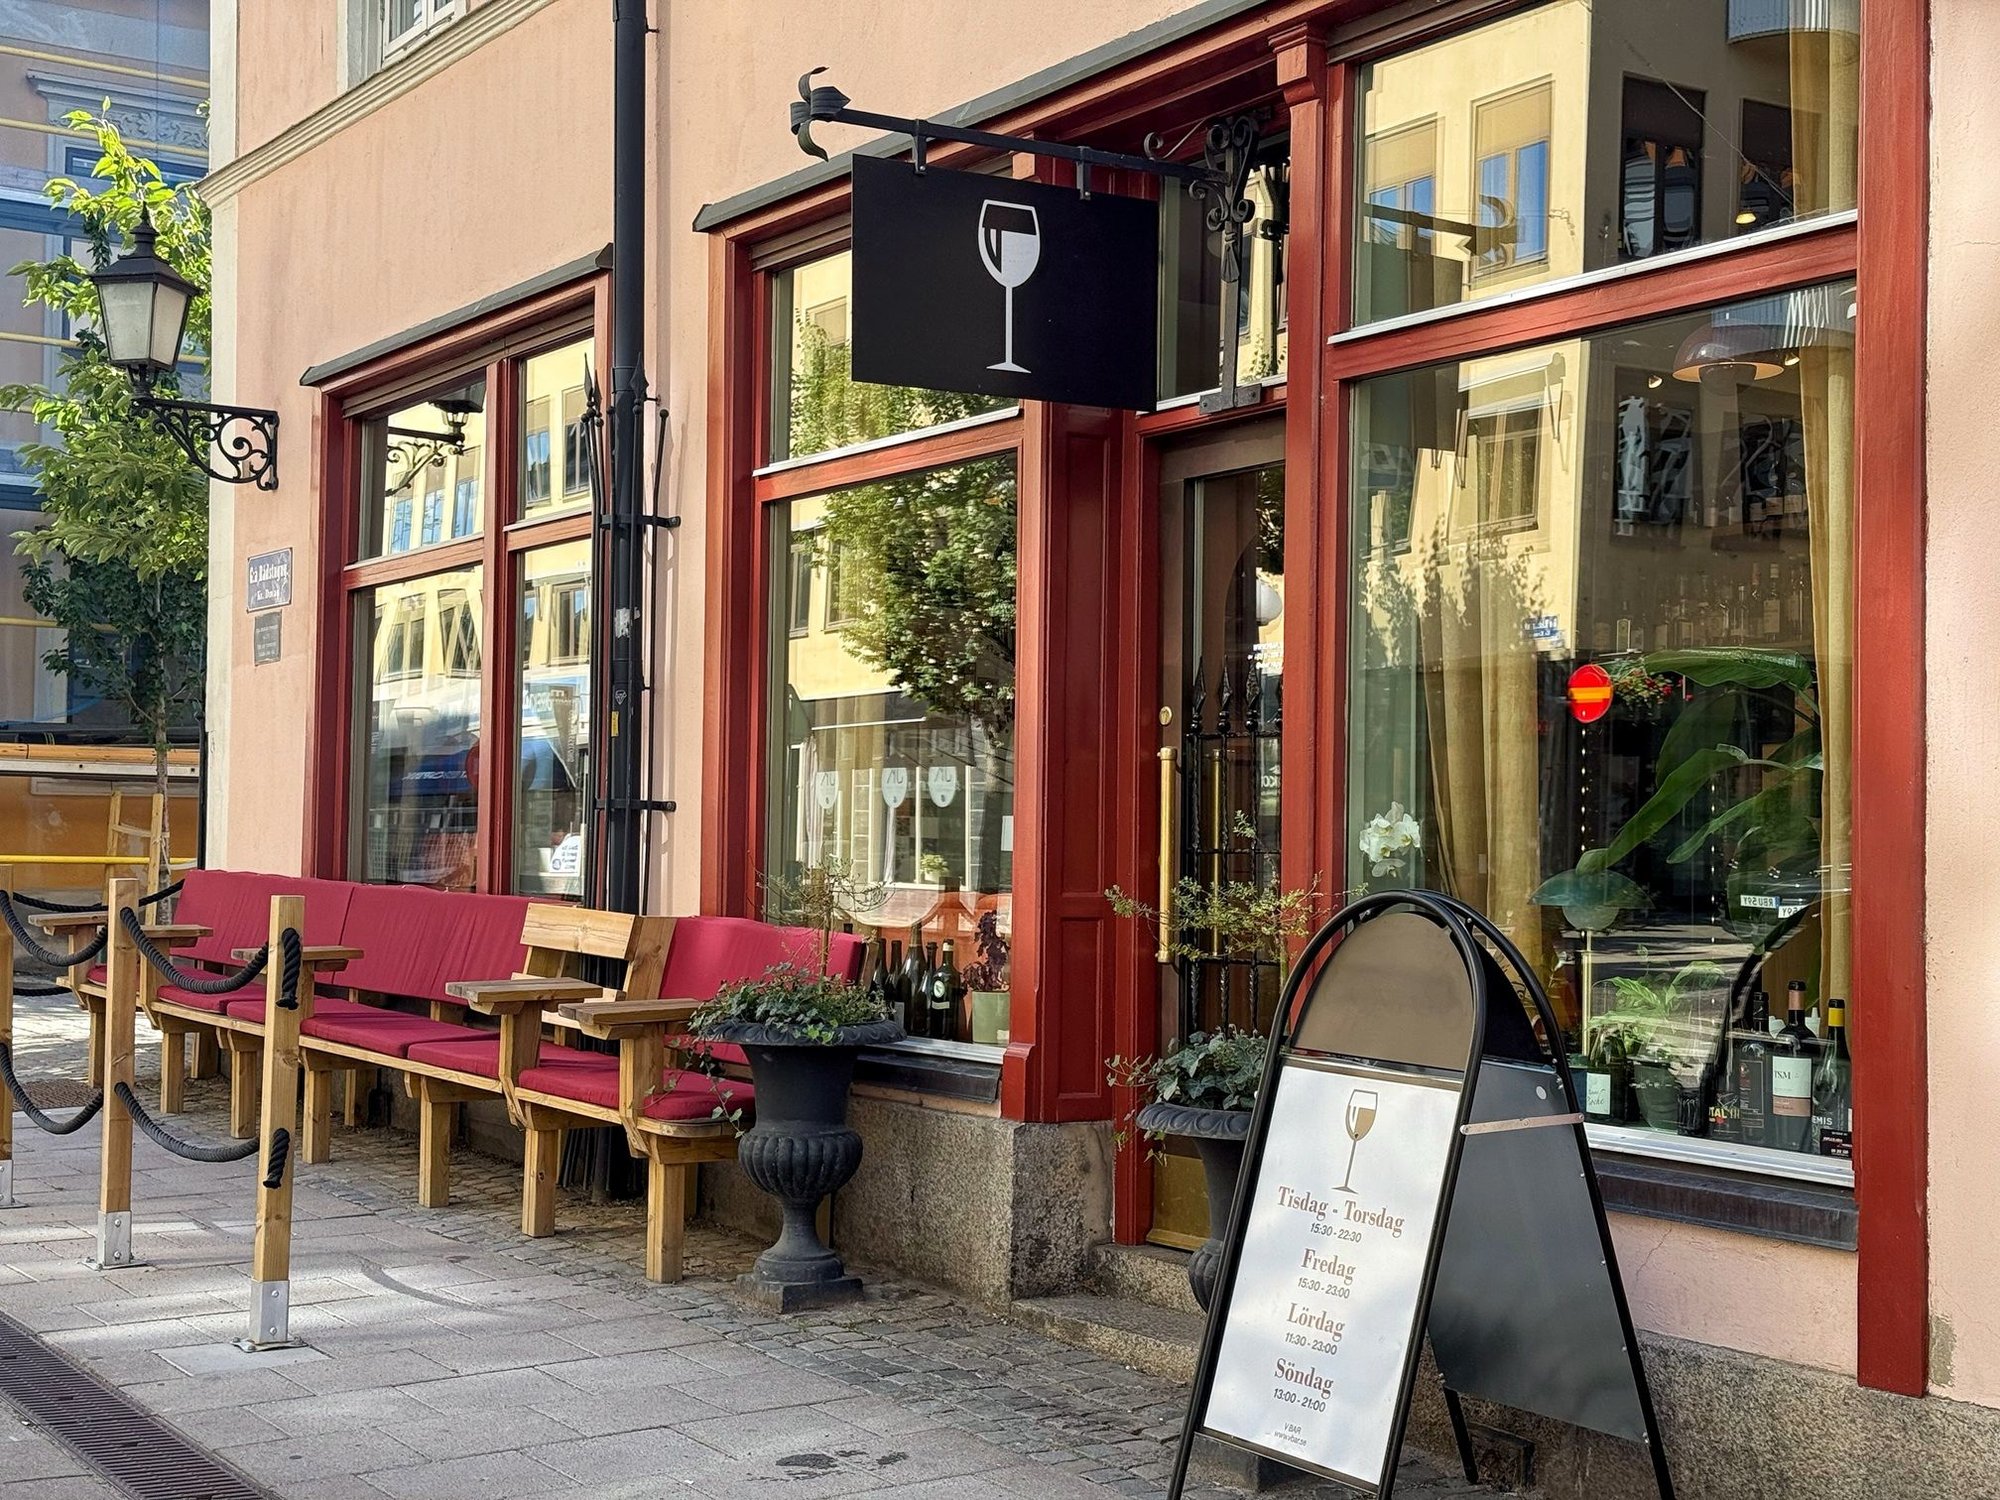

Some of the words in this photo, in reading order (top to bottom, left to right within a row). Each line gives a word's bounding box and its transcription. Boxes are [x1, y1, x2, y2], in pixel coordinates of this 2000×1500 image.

[1277, 1185, 1329, 1222] Tisdag
[1343, 1199, 1406, 1239] Torsdag
[1310, 1222, 1333, 1237] 15:30
[1337, 1228, 1362, 1243] 22:30
[1300, 1247, 1357, 1287] Fredag
[1297, 1276, 1321, 1292] 15:30
[1325, 1283, 1351, 1299] 23:00
[1286, 1302, 1346, 1343] Lördag
[1284, 1332, 1307, 1347] 11:30
[1311, 1339, 1338, 1355] 23:00
[1273, 1357, 1335, 1400] Söndag
[1273, 1388, 1297, 1404] 13:00
[1300, 1396, 1327, 1413] 21:00
